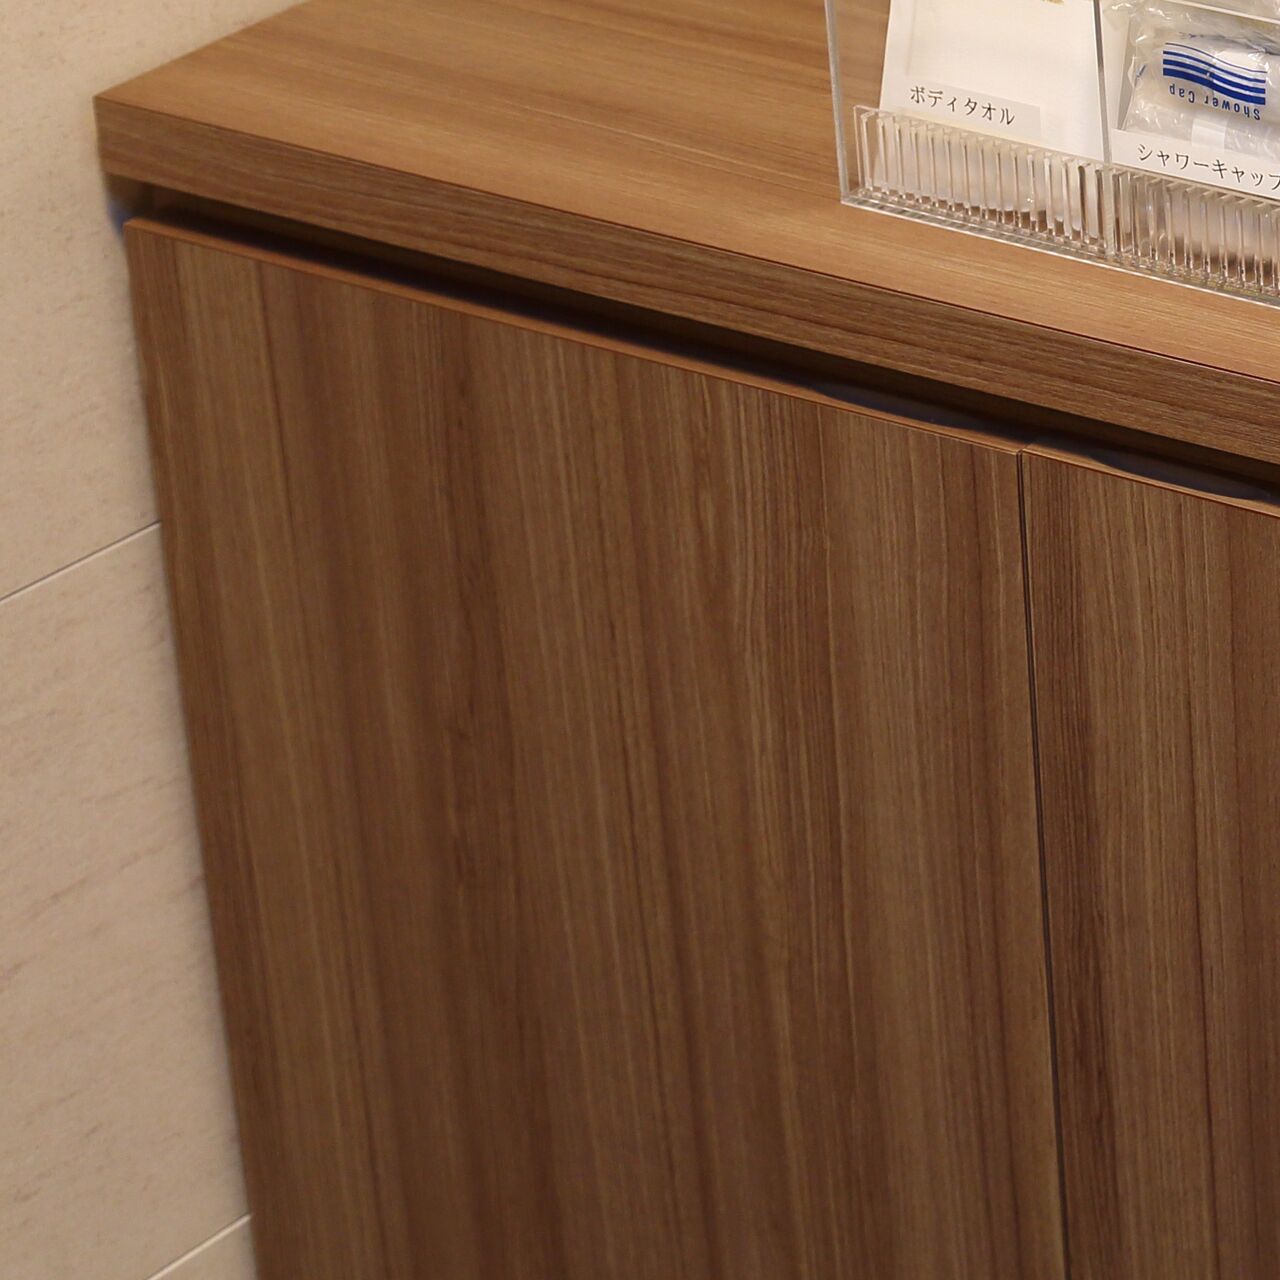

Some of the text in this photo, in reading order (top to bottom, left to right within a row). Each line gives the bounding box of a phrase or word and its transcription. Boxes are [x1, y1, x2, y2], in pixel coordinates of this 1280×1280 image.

[910, 85, 1016, 126] ボディタオル
[1169, 83, 1261, 121] Shower Cap
